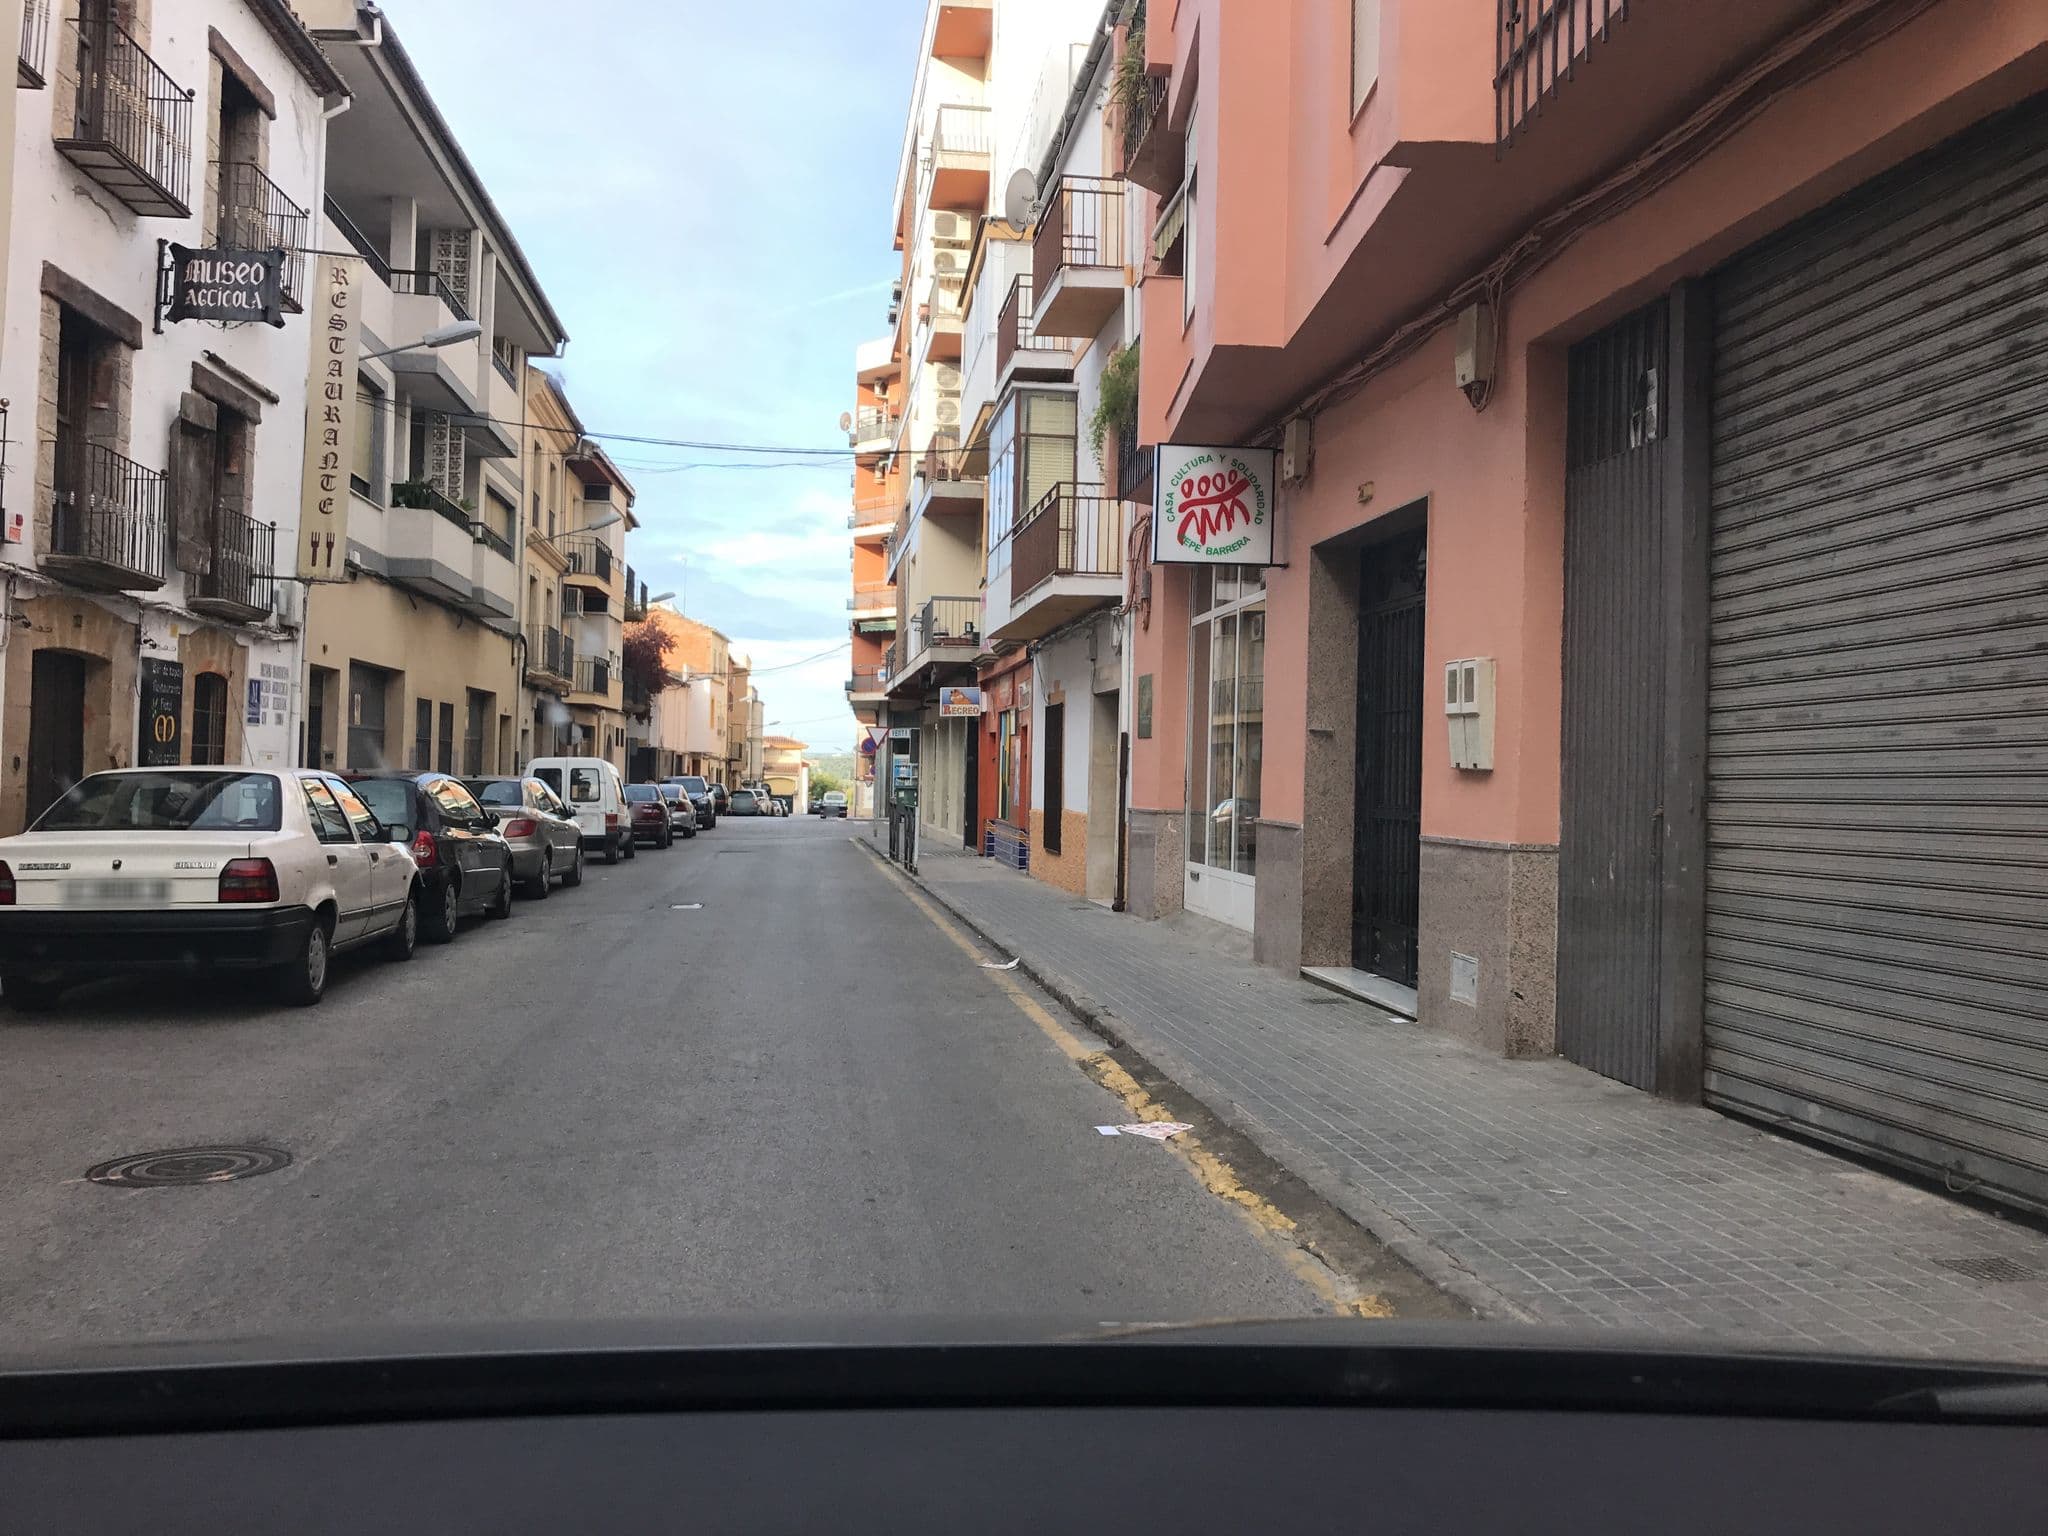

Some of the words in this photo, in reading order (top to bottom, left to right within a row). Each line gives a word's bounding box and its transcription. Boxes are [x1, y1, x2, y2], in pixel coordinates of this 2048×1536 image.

[318, 267, 349, 514] RESTAURANTE
[1165, 492, 1176, 522] CASA
[1171, 454, 1214, 487] CULTURA
[1219, 454, 1226, 463] Y
[1230, 458, 1265, 525] SOLIDARIDAD
[1205, 535, 1251, 556] BARRERA
[943, 704, 979, 715] RECREO
